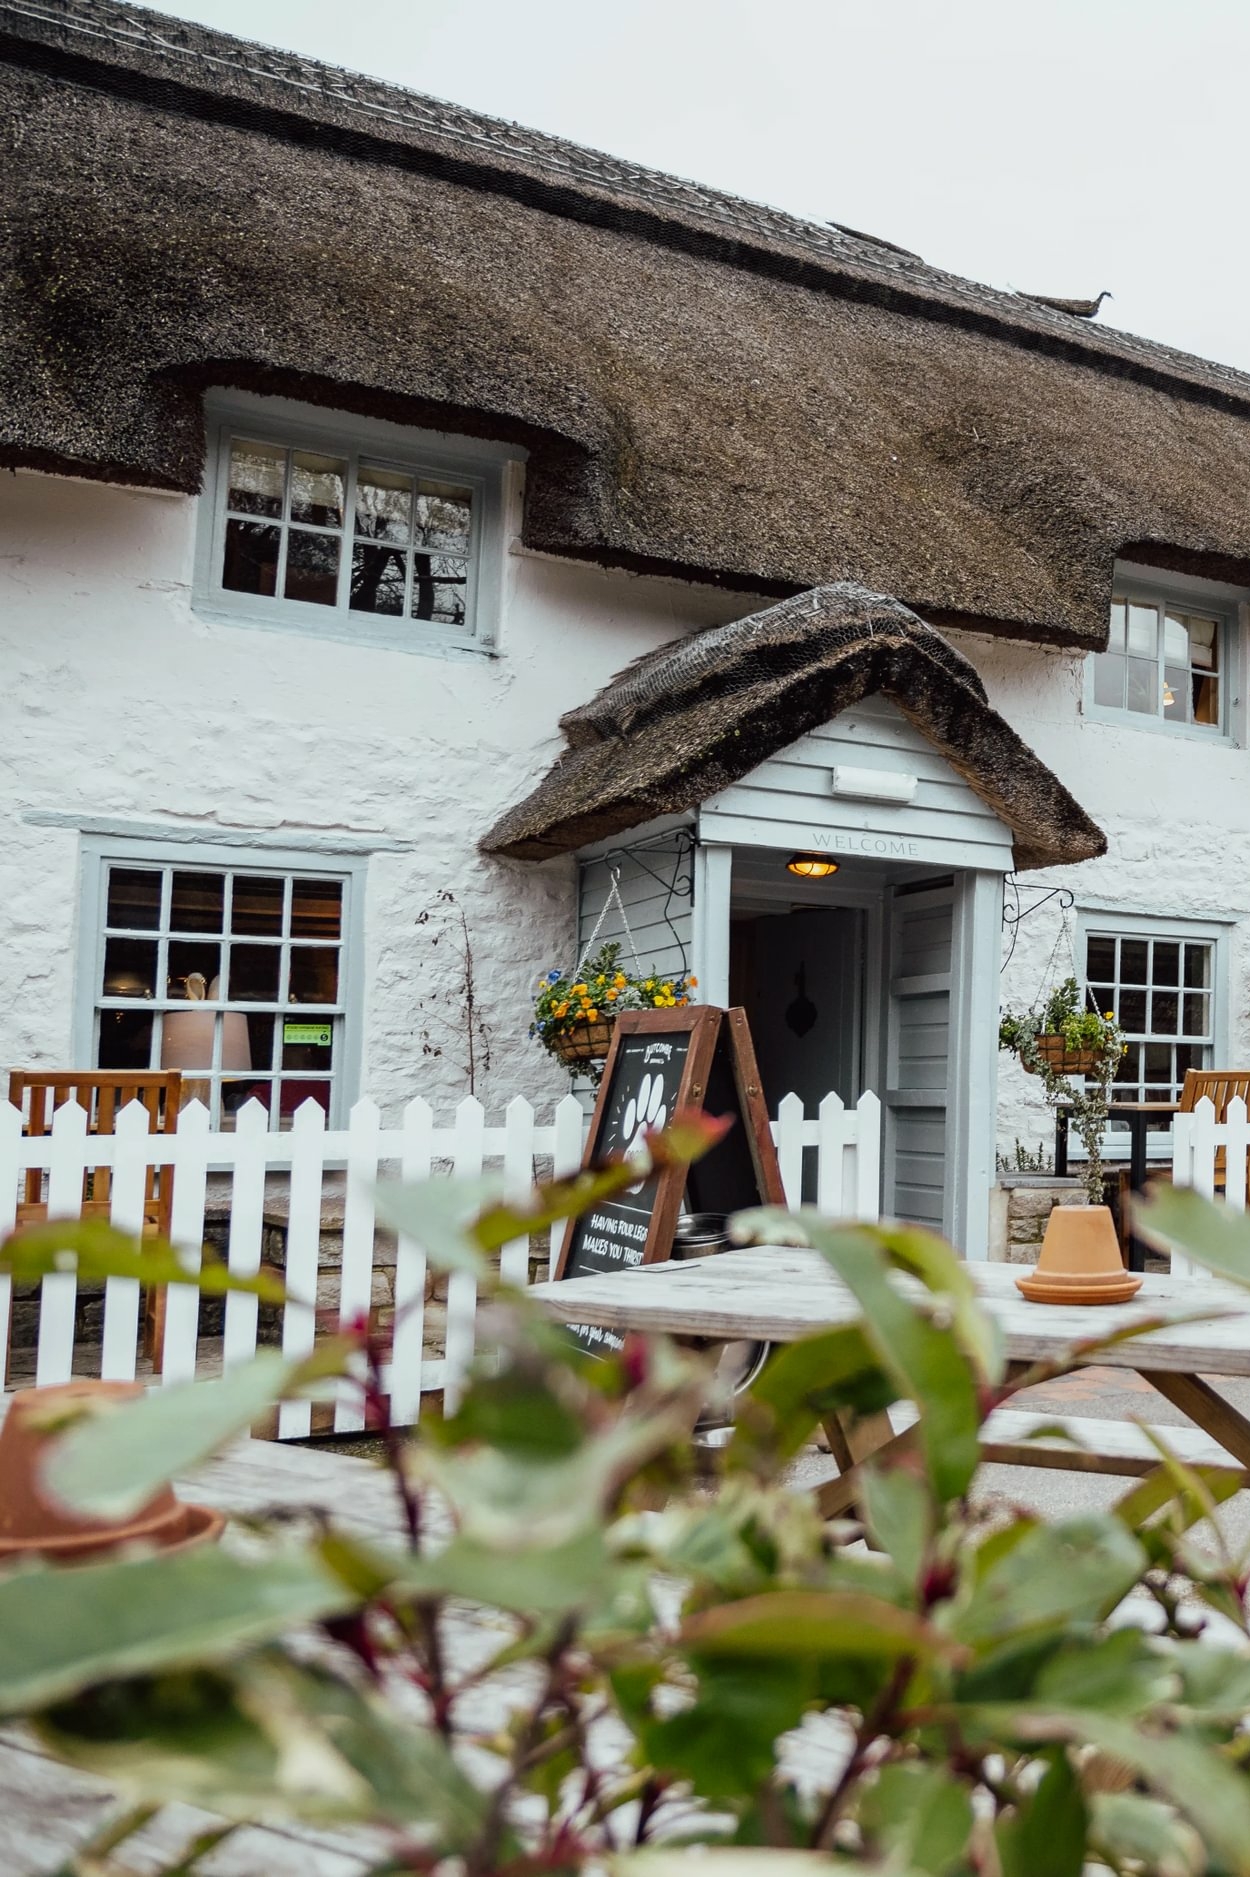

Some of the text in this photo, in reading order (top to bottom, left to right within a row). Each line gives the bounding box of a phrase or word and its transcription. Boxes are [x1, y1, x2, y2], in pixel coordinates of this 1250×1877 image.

[812, 832, 919, 857] WELCOME
[591, 1213, 618, 1234] HAVING
[617, 1220, 633, 1237] FOUR
[582, 1233, 609, 1256] MAKES
[608, 1242, 623, 1260] YOU
